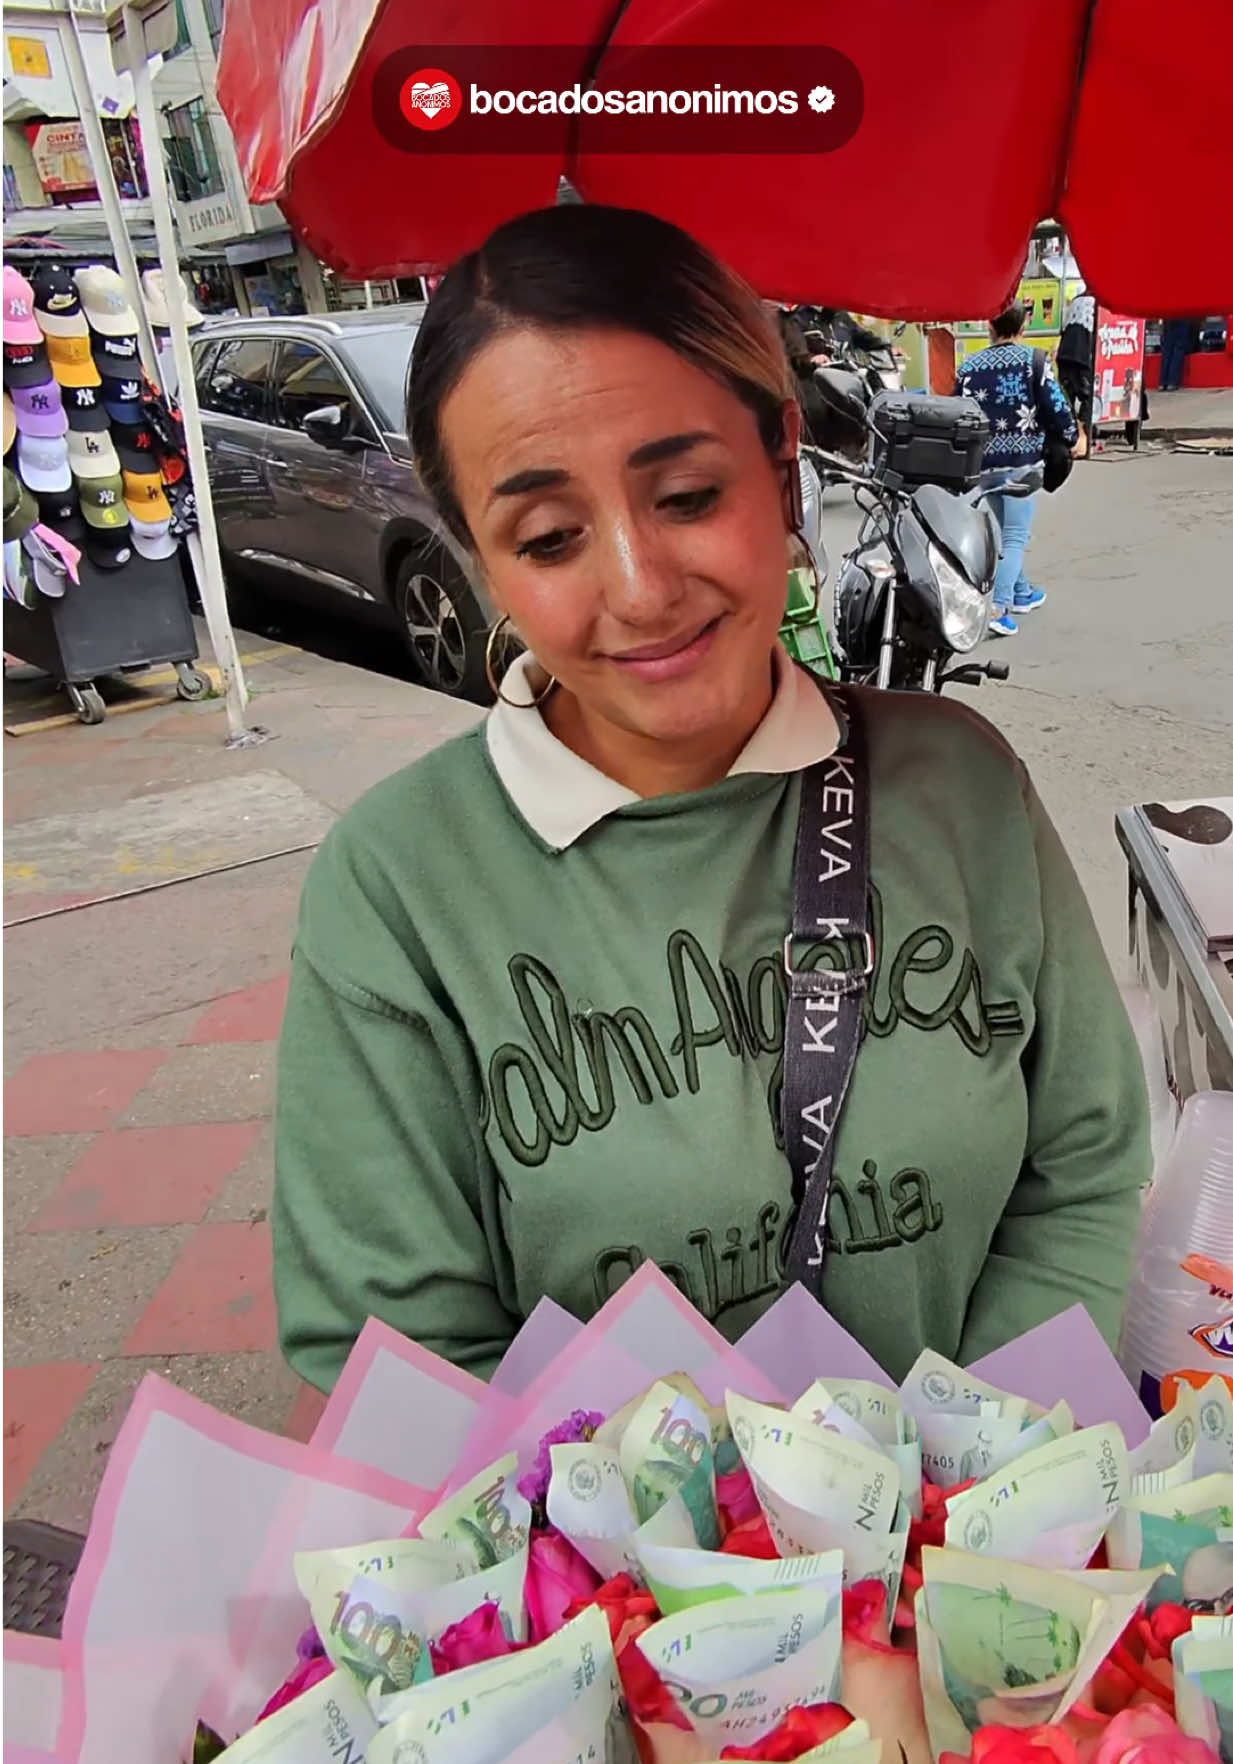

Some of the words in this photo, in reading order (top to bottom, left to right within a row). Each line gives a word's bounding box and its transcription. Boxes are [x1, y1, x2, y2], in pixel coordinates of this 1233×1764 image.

[189, 204, 233, 232] FLORIDA
[76, 388, 96, 406] NY
[818, 755, 854, 882] KEVA
[480, 952, 679, 1168] alm
[870, 1471, 886, 1510] PESOS
